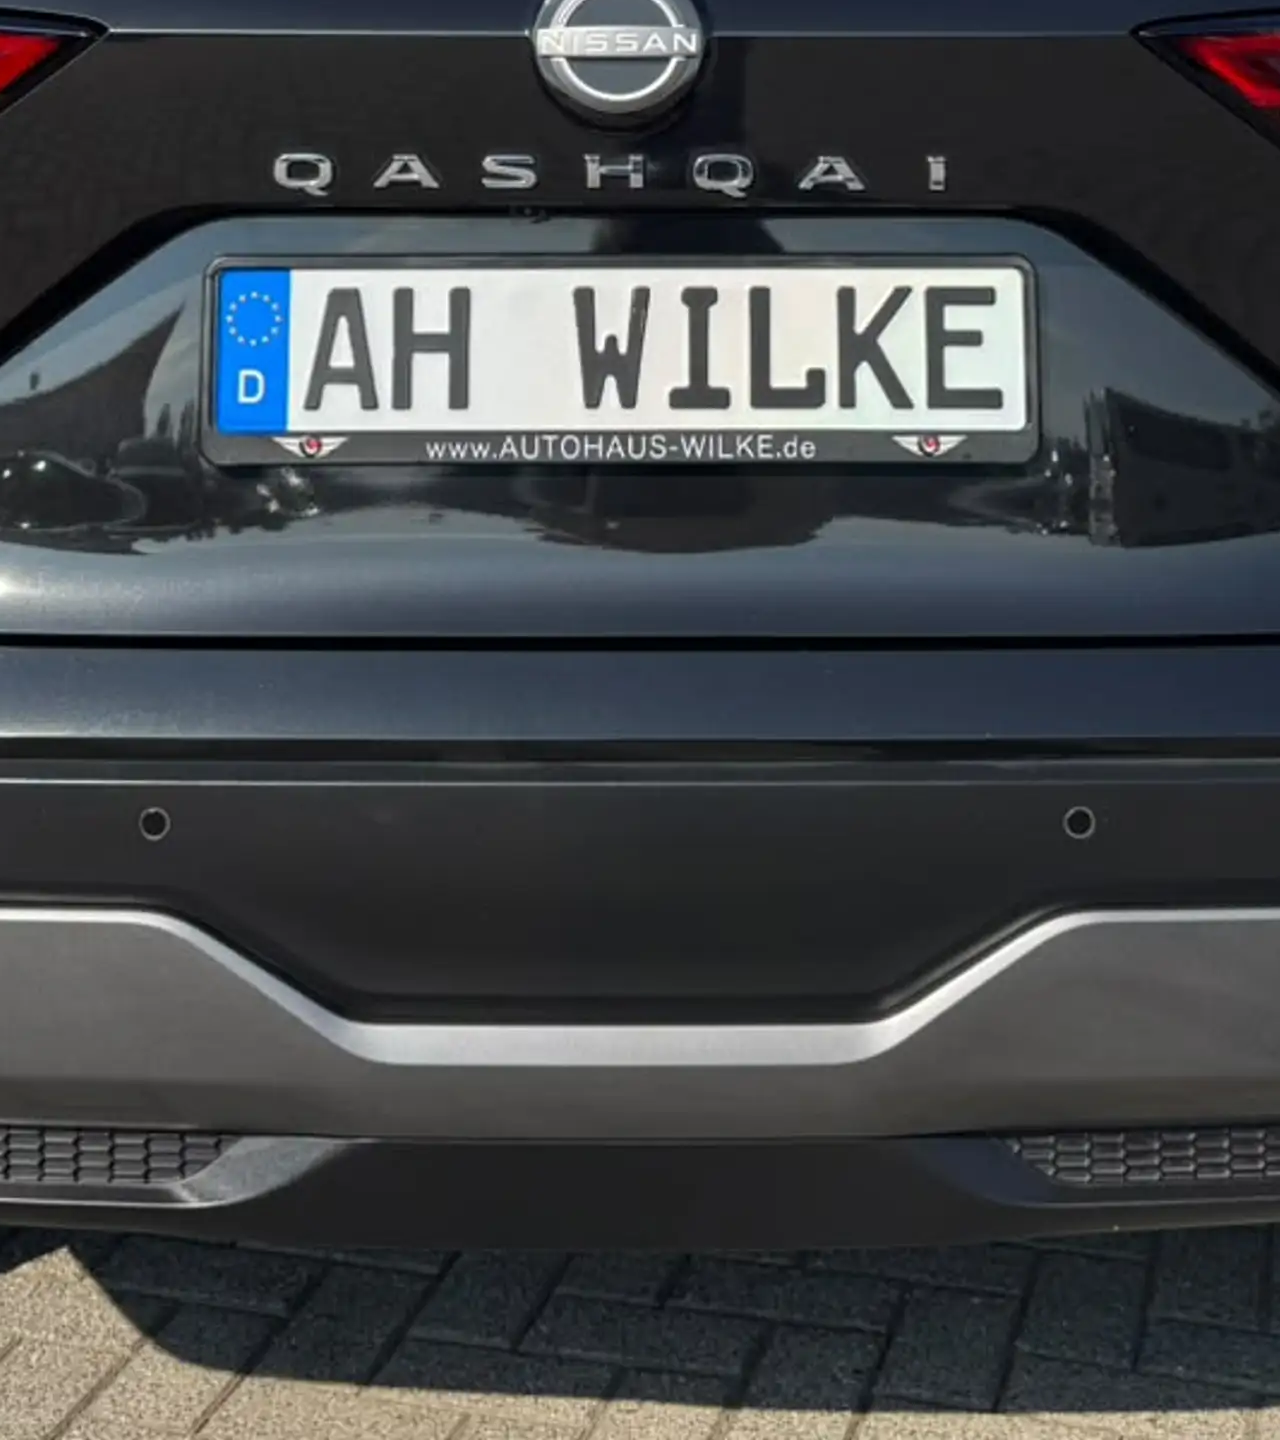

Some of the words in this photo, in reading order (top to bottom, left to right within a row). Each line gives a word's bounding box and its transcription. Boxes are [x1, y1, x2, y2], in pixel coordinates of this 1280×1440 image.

[540, 30, 698, 55] NISSAN
[273, 153, 946, 198] QASHQAI
[303, 288, 471, 410] AH
[573, 287, 1003, 410] WILKE
[237, 371, 265, 403] D
[425, 434, 817, 459] www.AUTOHAUS-WILKE.de
